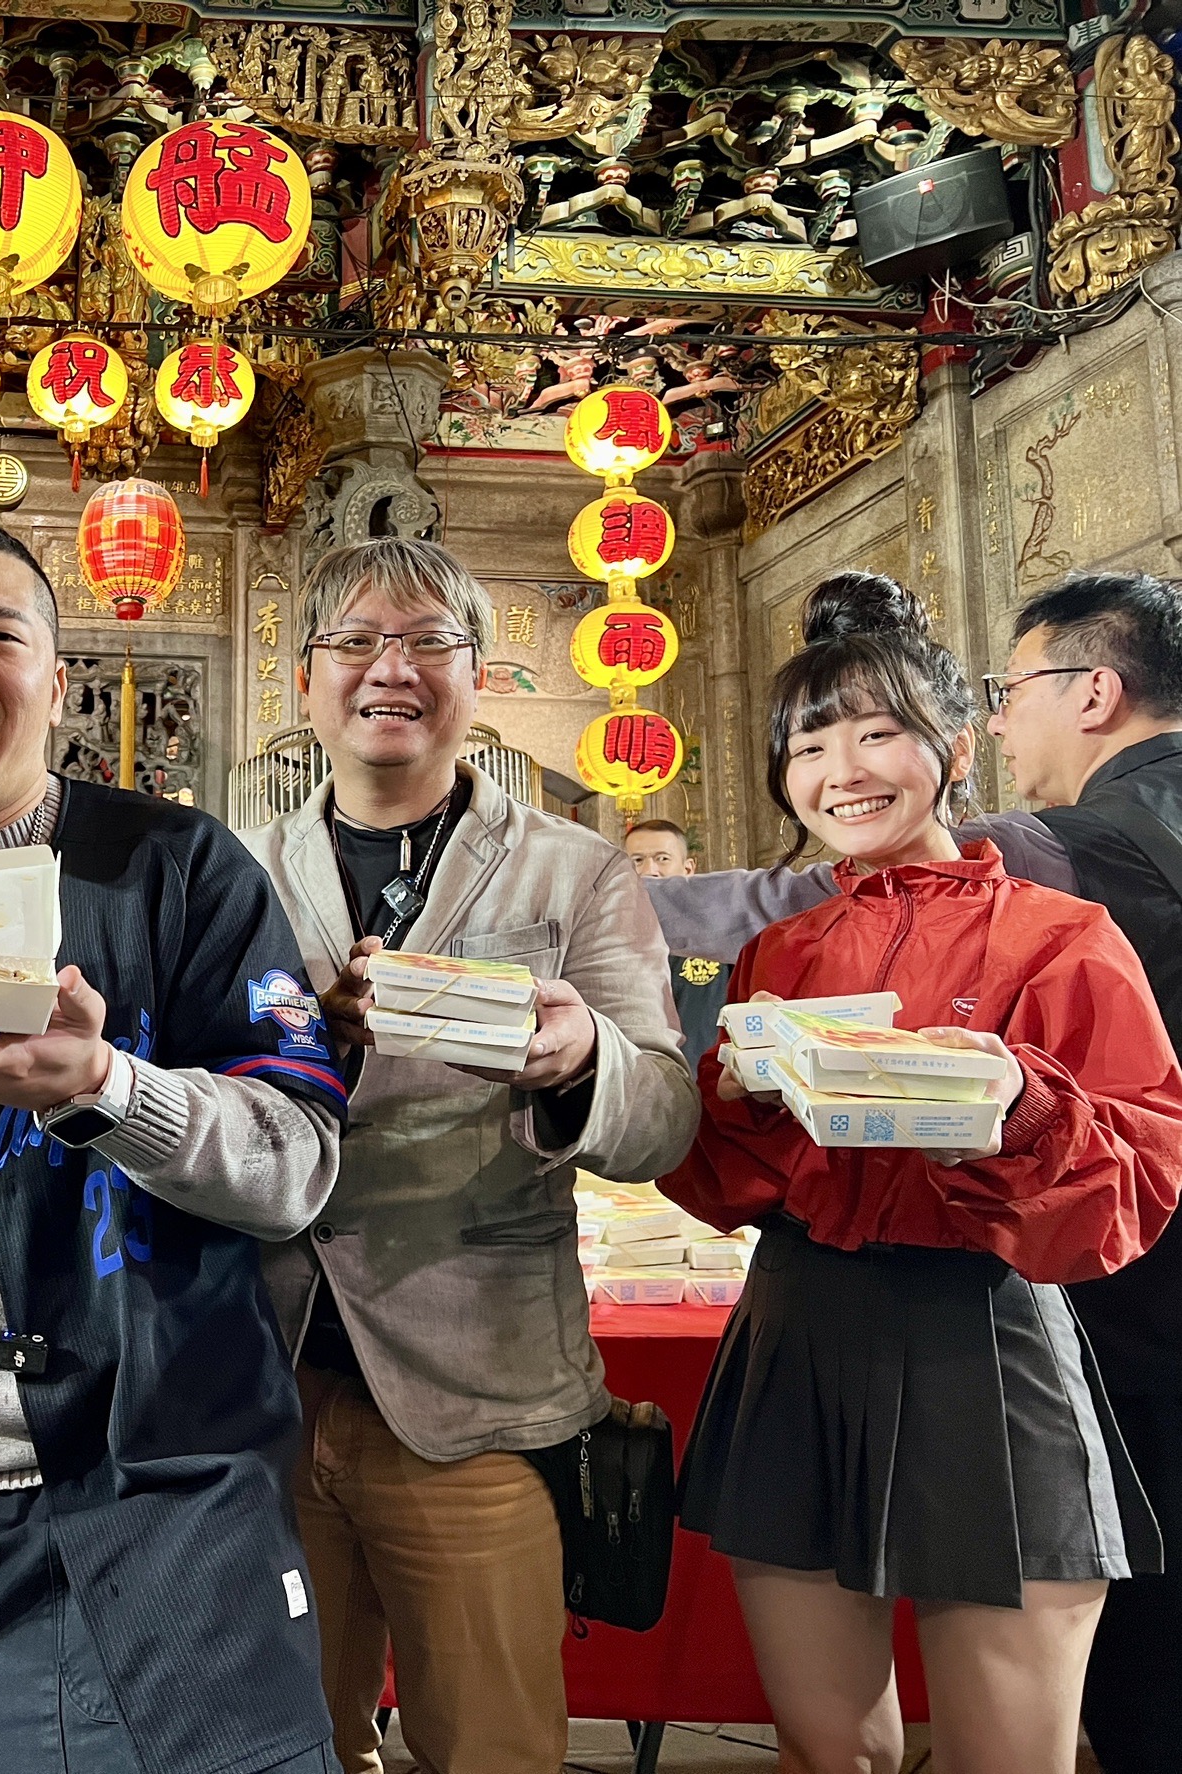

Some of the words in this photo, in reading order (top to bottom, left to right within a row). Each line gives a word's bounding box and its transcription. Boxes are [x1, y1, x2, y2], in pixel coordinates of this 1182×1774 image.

[145, 120, 293, 244] 艋
[40, 340, 111, 408] 祝
[169, 344, 244, 408] 恭
[594, 390, 664, 454] 風
[597, 499, 668, 566] 調
[599, 613, 666, 672] 雨
[603, 714, 676, 779] 順
[290, 1033, 316, 1045] WBSC
